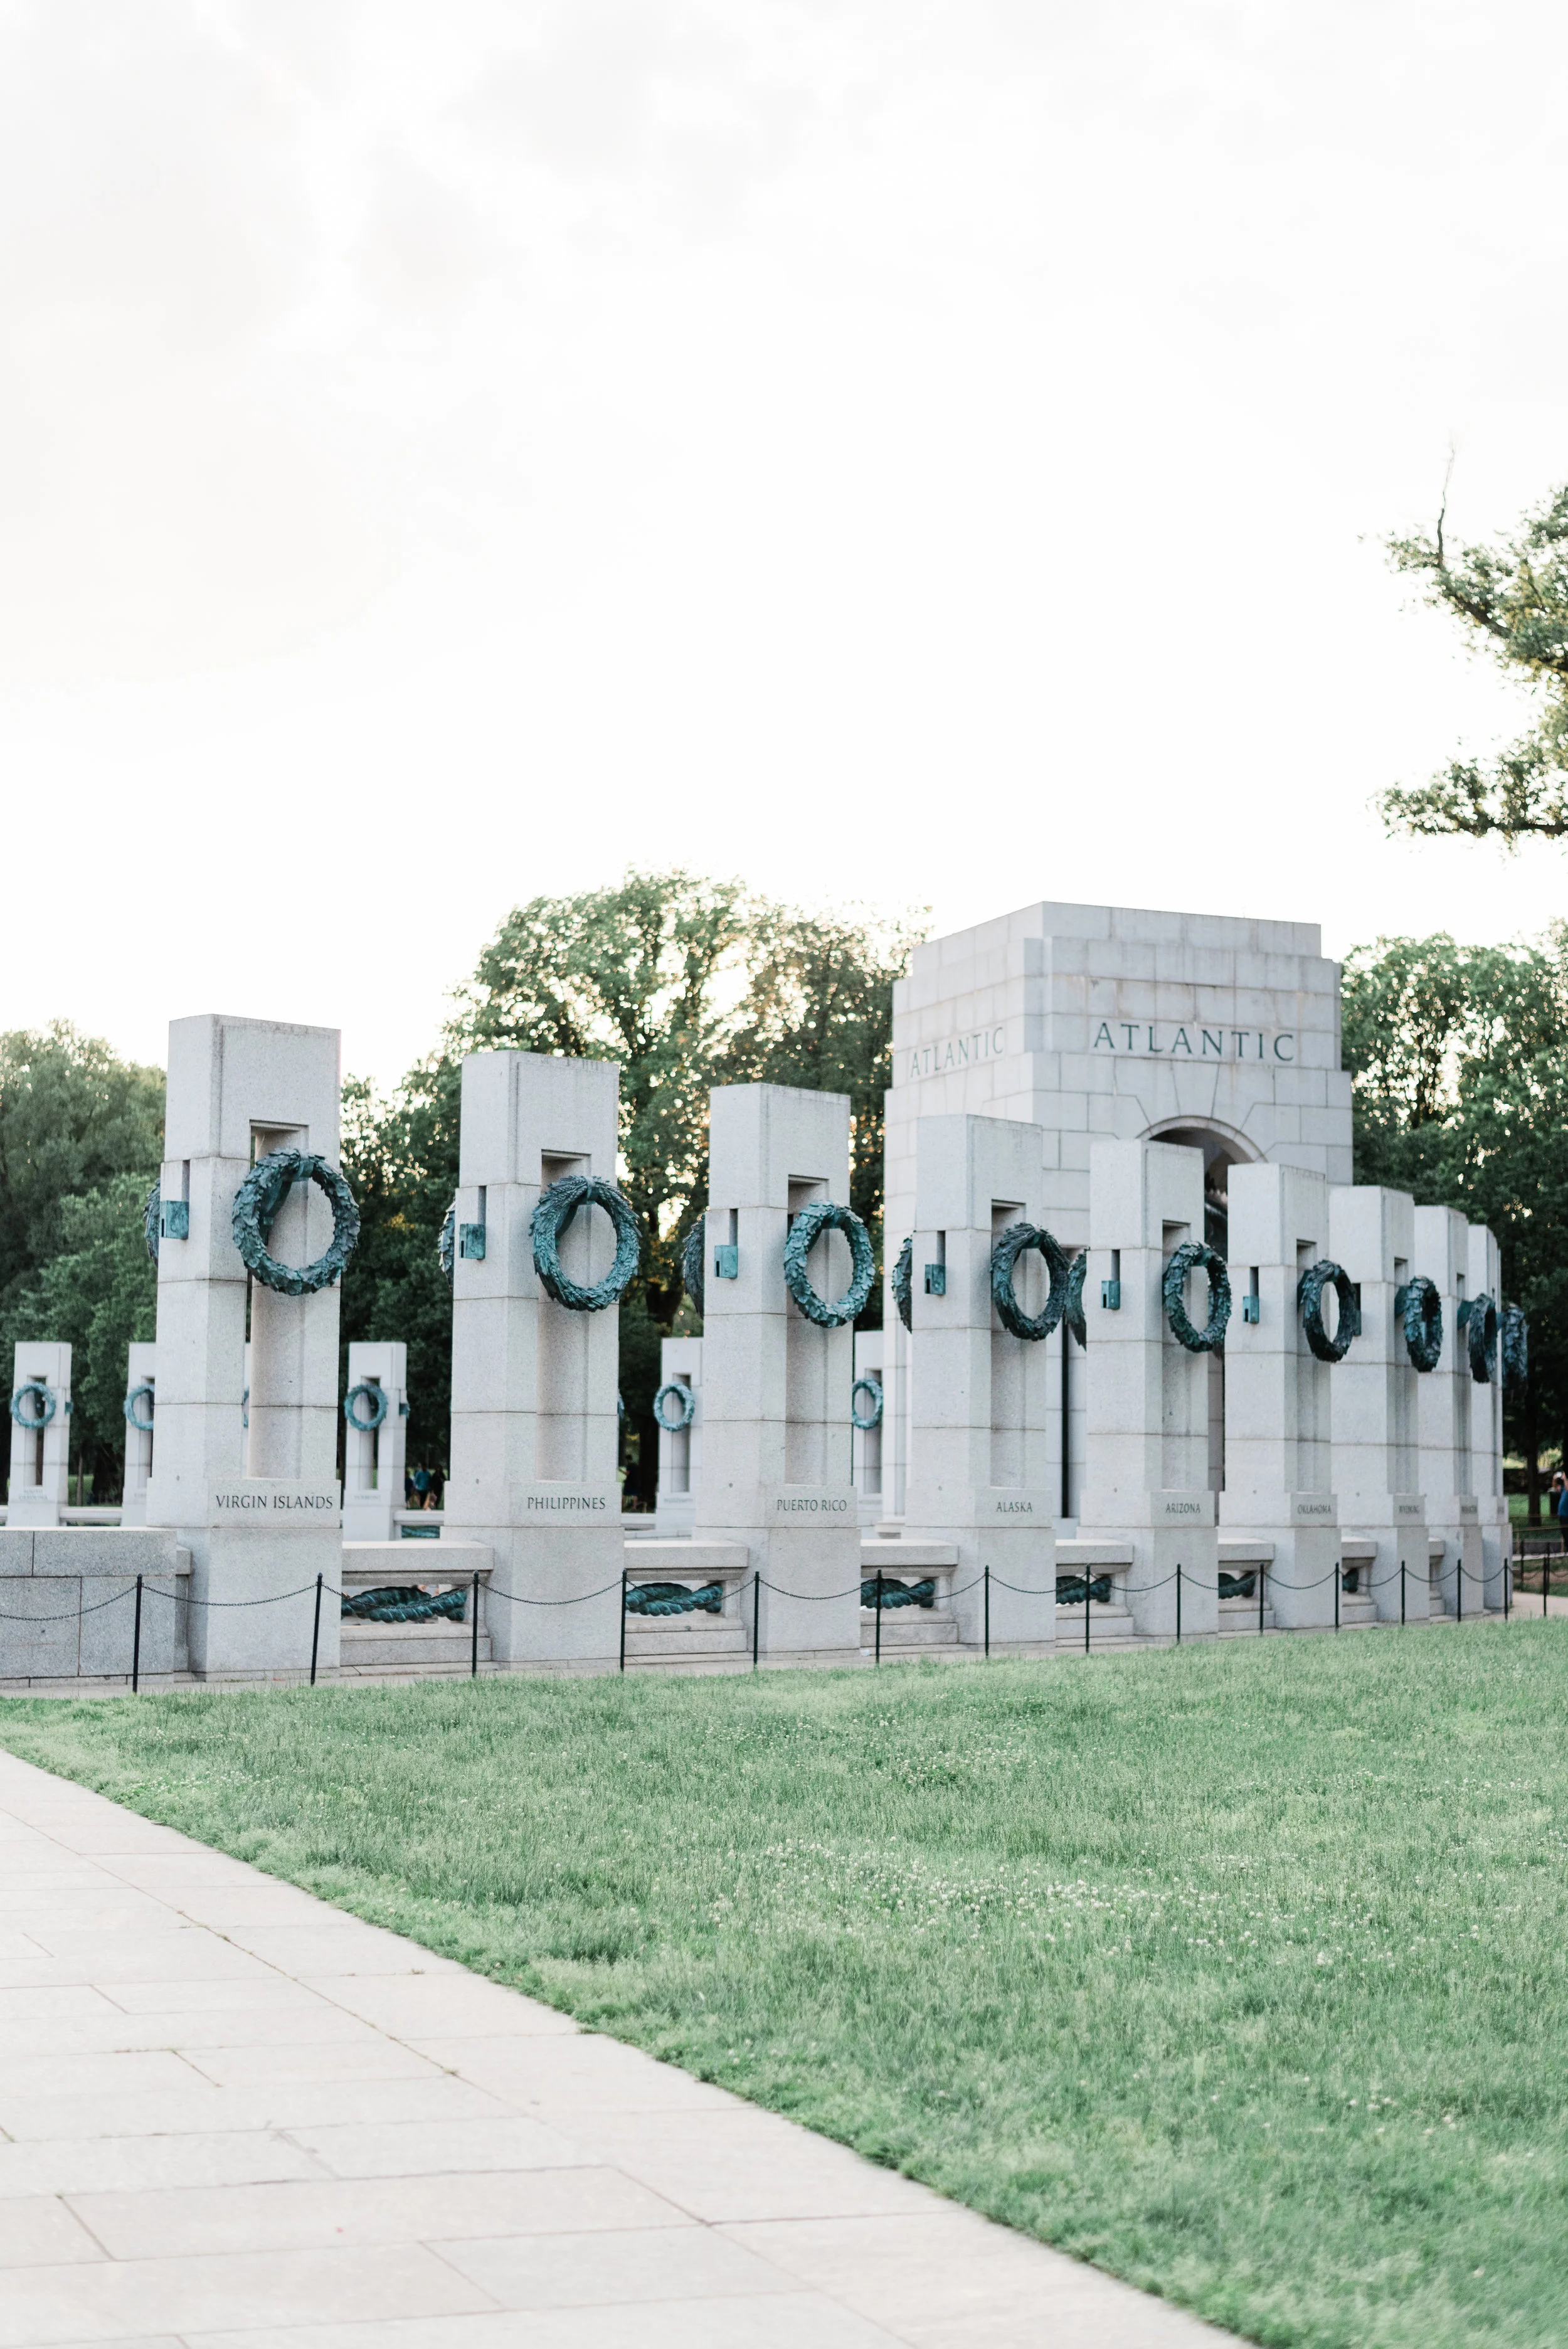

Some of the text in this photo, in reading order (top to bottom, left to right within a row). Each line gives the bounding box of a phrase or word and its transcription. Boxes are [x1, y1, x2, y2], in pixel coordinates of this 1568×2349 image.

[1093, 1022, 1294, 1061] ATLANTIC
[910, 1026, 1004, 1078] ATLANTIC
[216, 1495, 333, 1509] VIRGIN ISLANDS
[527, 1497, 606, 1509] PHILIPPINES
[777, 1499, 818, 1511] PUERTO
[821, 1500, 847, 1511] RICO
[996, 1502, 1032, 1512] ALASKA
[1165, 1503, 1200, 1514] ARIZONA
